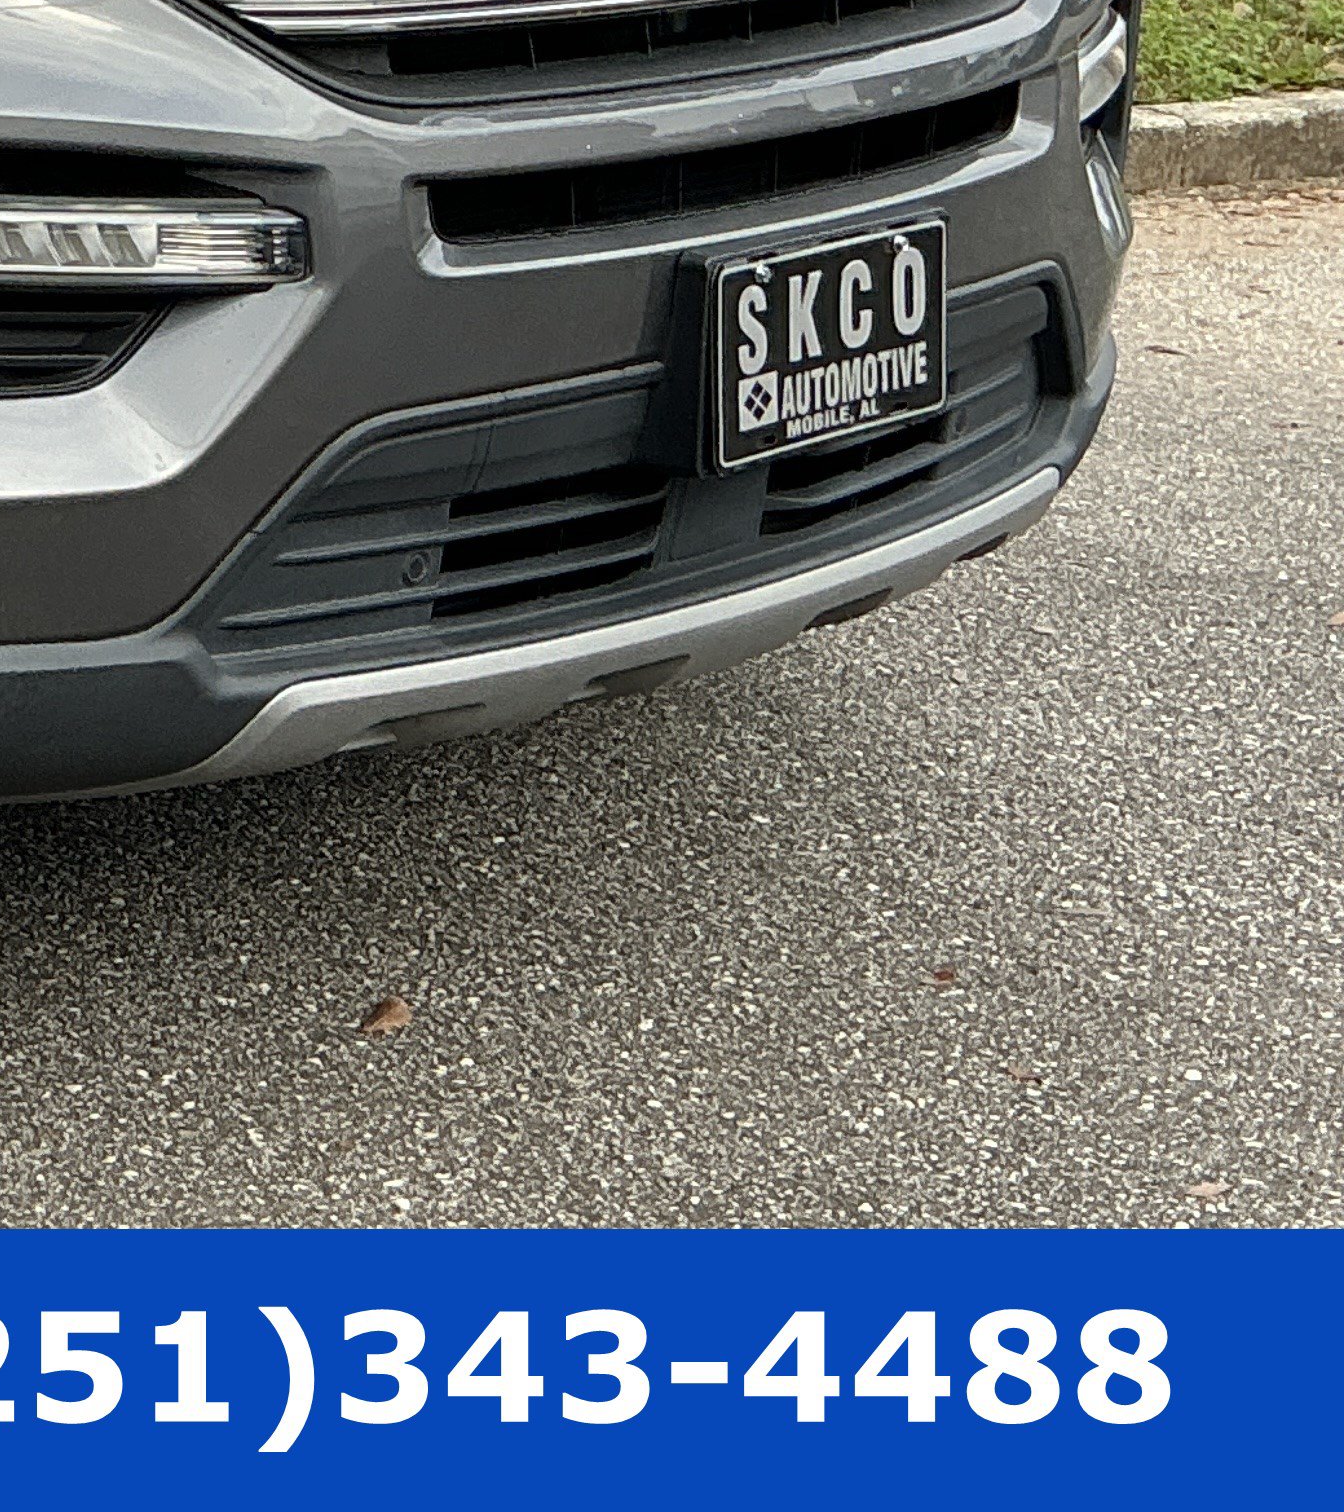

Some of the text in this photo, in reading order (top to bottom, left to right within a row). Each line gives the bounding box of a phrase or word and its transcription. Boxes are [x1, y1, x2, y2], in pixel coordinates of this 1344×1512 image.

[738, 246, 927, 376] SKCO
[781, 340, 929, 421] AUTOMOTIVE
[786, 397, 881, 440] MOBILE, AL
